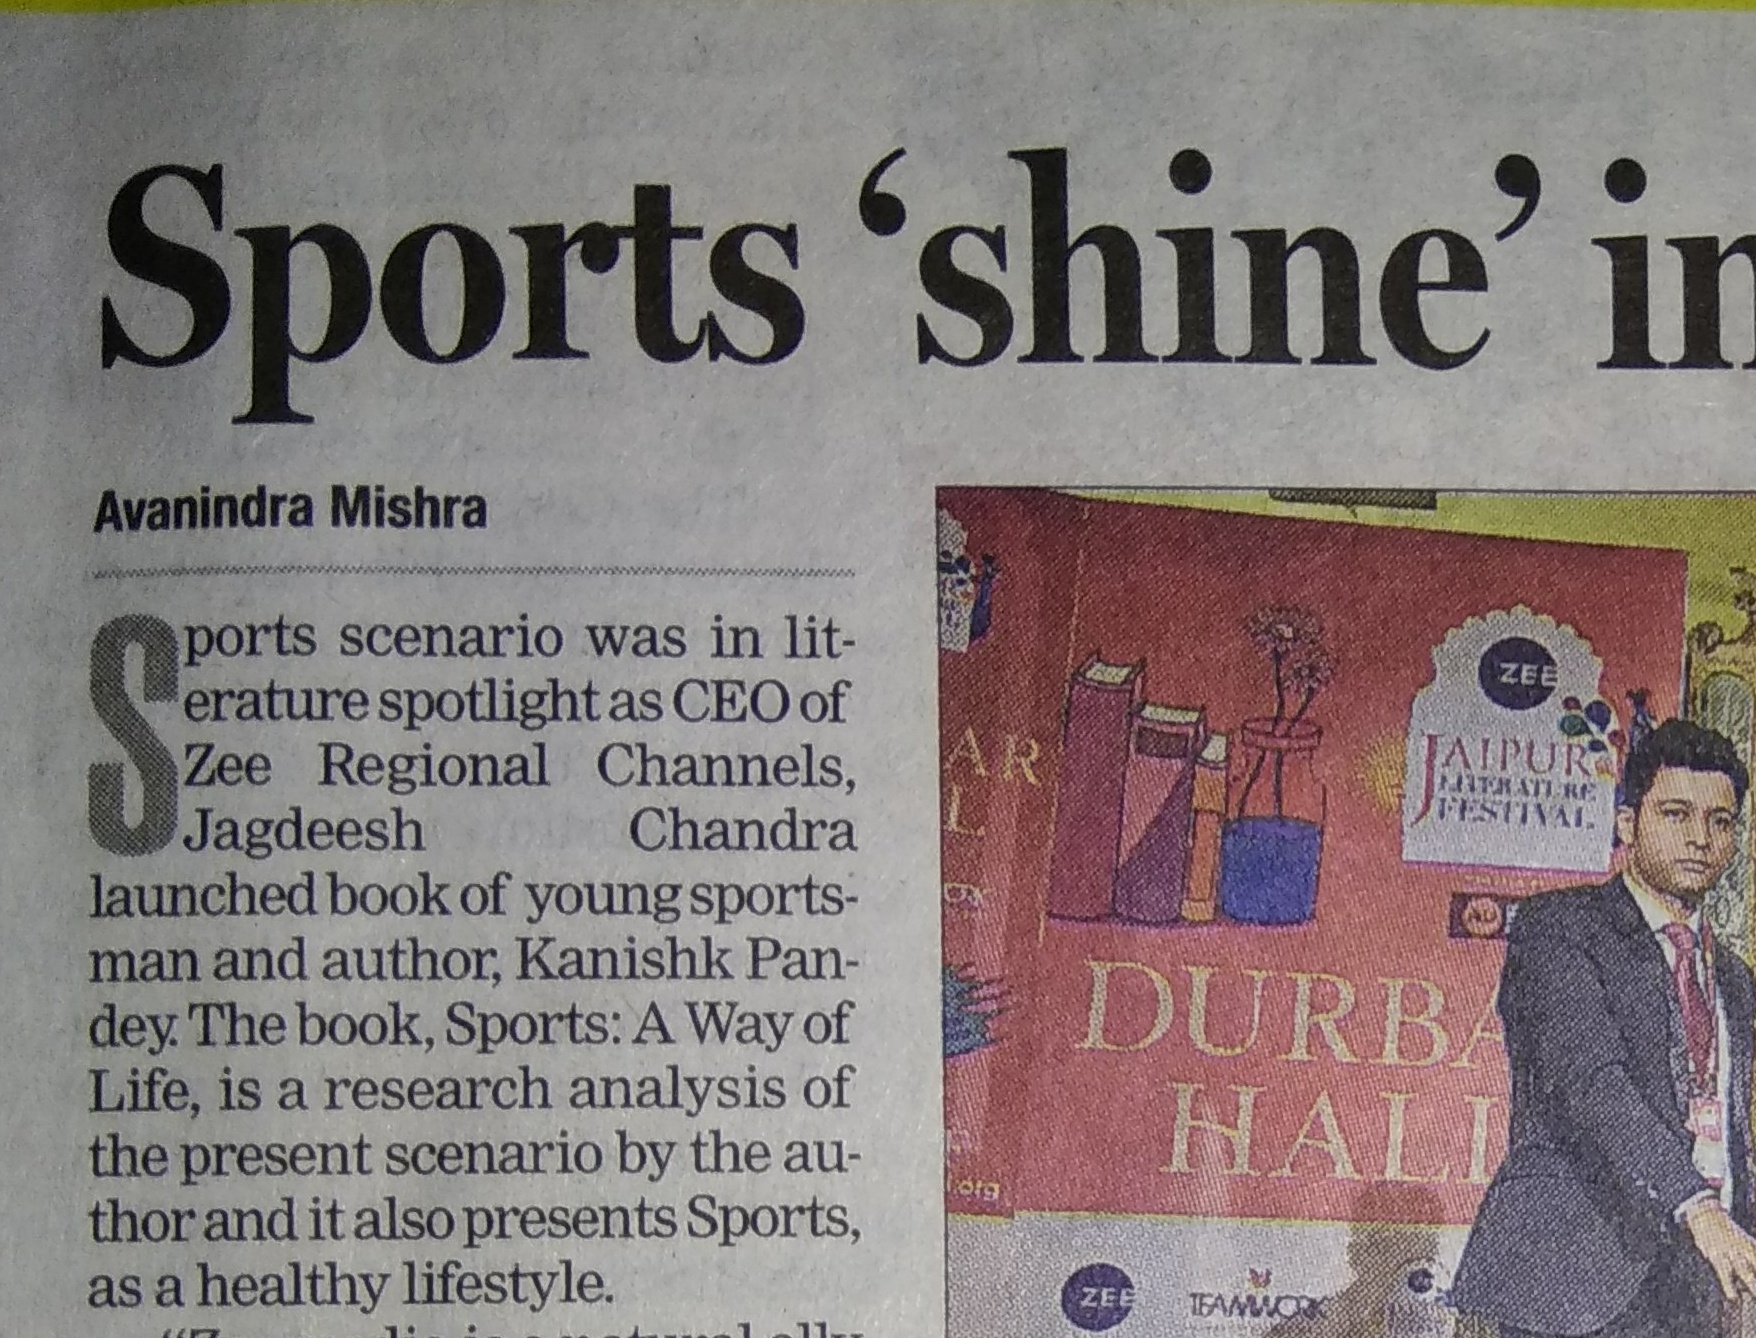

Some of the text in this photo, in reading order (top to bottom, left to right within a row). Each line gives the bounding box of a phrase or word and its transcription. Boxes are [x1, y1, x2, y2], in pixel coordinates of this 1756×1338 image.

[100, 162, 806, 426] Sports
[858, 146, 1542, 372] ‘shine’
[92, 484, 487, 534] Avanindra Mishra
[1497, 661, 1559, 686] ZEE
[183, 741, 856, 796] Zee Regional Channels,
[1409, 733, 1591, 829] JAIPUR
[1438, 773, 1597, 802] LITERATURE
[1437, 797, 1595, 830] FESTIVAL
[89, 870, 859, 925] launched book of young sports-
[88, 1064, 857, 1120] Life, is a research analysis of
[1080, 1286, 1136, 1308] ZEE
[1188, 1291, 1332, 1319] TEAMWORK
